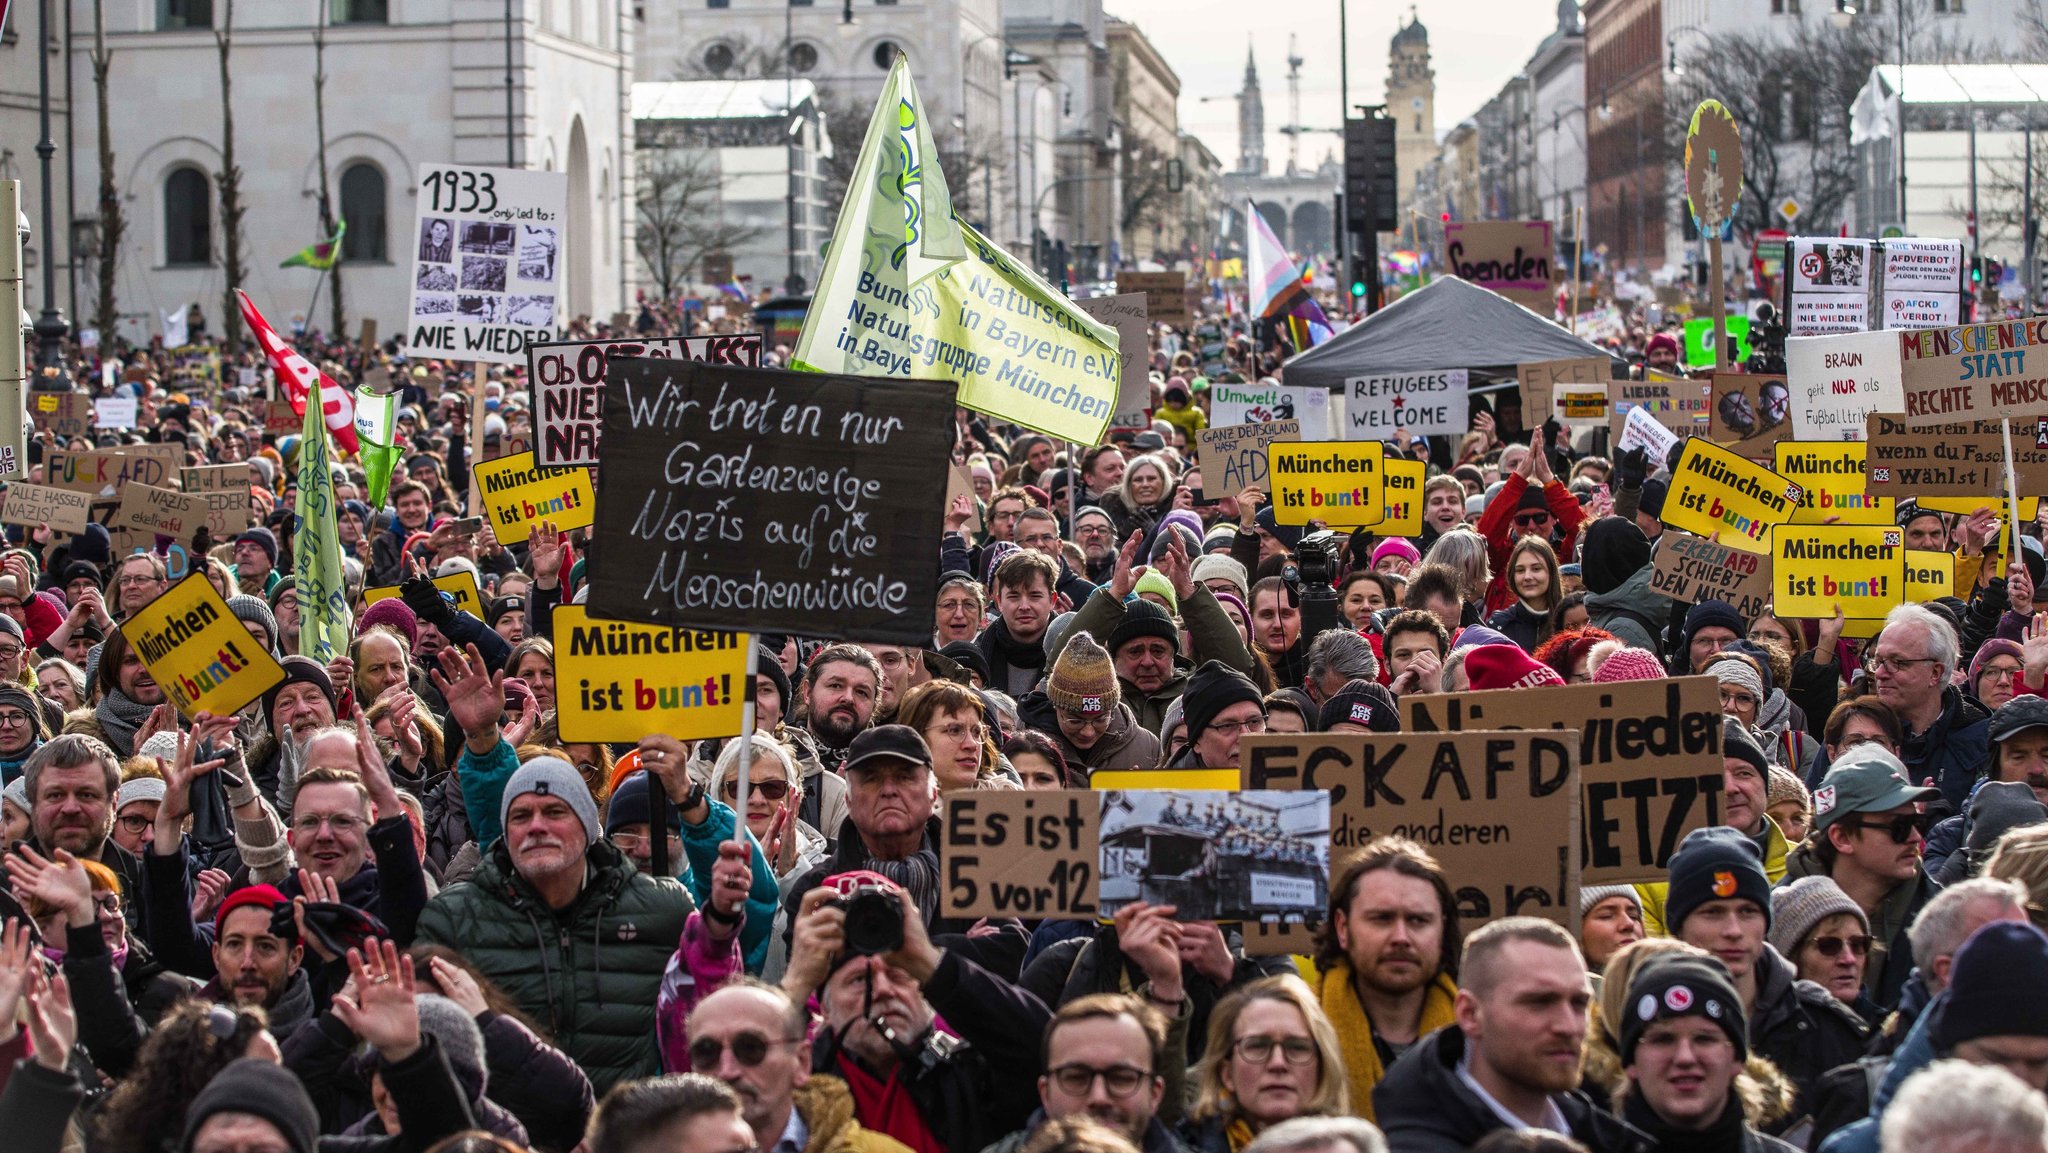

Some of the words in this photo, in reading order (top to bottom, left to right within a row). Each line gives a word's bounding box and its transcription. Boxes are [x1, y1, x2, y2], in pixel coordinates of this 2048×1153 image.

[422, 170, 498, 214] 1933
[516, 207, 533, 221] led
[1891, 255, 1950, 264] AFDVERBOT
[1905, 300, 1939, 309] AFCKD
[1819, 314, 1857, 323] WIEDER
[1902, 313, 1942, 322] VERBOT
[412, 325, 456, 351] NIE
[836, 326, 857, 354] in
[959, 300, 981, 330] in
[985, 316, 1078, 369] Bayern
[1825, 352, 1863, 369] BRAUN
[1960, 350, 2026, 381] STATT
[995, 359, 1111, 420] München
[1216, 387, 1278, 406] Umwelt
[1354, 374, 1449, 399] REFUGEES
[1622, 386, 1671, 399] LIEBER
[1807, 383, 1825, 404] geht
[1832, 379, 1857, 395] NUR
[1863, 377, 1880, 393] als
[624, 376, 700, 429] Wir
[708, 382, 823, 436] treten
[840, 408, 905, 445] nur
[1906, 386, 1974, 417] RECHTE
[1352, 407, 1448, 428] WELCOME
[1878, 416, 1907, 435] Du
[1202, 429, 1235, 443] GANZ
[1238, 421, 1300, 441] DEUTSCHLAND
[1214, 440, 1239, 454] HASST
[1875, 444, 1928, 460] wenn
[1933, 441, 1960, 461] du
[48, 455, 110, 485] FUCK
[117, 454, 164, 490] AFD
[664, 440, 882, 512] Gartenzwerge
[1223, 449, 1269, 493] AfD
[1277, 452, 1374, 475] München
[1873, 467, 1890, 475] FCK
[1686, 452, 1787, 513] München
[1873, 474, 1890, 482] NZS
[1897, 467, 1977, 486] Wählst
[44, 490, 87, 509] HASSEN
[149, 490, 191, 513] NAZIS
[496, 503, 521, 525] ist
[522, 487, 582, 520] bunt!
[1283, 486, 1305, 507] ist
[1310, 485, 1370, 508] bunt!
[131, 512, 183, 534] ekelhafd
[1679, 485, 1707, 513] ist
[1708, 497, 1770, 542] bunt!
[630, 489, 744, 542] Nazis
[764, 504, 830, 570] auf
[828, 511, 879, 559] die
[1884, 532, 1900, 540] FCK
[1670, 538, 1758, 575] EKELHAFD
[1783, 538, 1894, 561] München
[643, 550, 909, 615] Menschenwürde
[1673, 556, 1748, 589] SCHIEBT
[1788, 573, 1816, 596] ist
[1823, 574, 1888, 597] bunt!
[1652, 569, 1689, 596] DEN
[1738, 595, 1763, 618] AB
[136, 601, 220, 667] München
[570, 623, 738, 657] München
[178, 640, 250, 702] bunt!
[165, 680, 192, 711] ist
[580, 679, 624, 712] ist
[634, 673, 732, 711] bunt!
[1082, 697, 1101, 705] FCK
[1082, 704, 1101, 712] AFD
[1350, 710, 1371, 721] AFD
[1351, 703, 1372, 716] FCK
[948, 799, 1010, 847] Es
[1024, 797, 1085, 852] ist
[1334, 815, 1371, 847] die
[1398, 806, 1510, 846] anderen
[948, 855, 980, 909] 5
